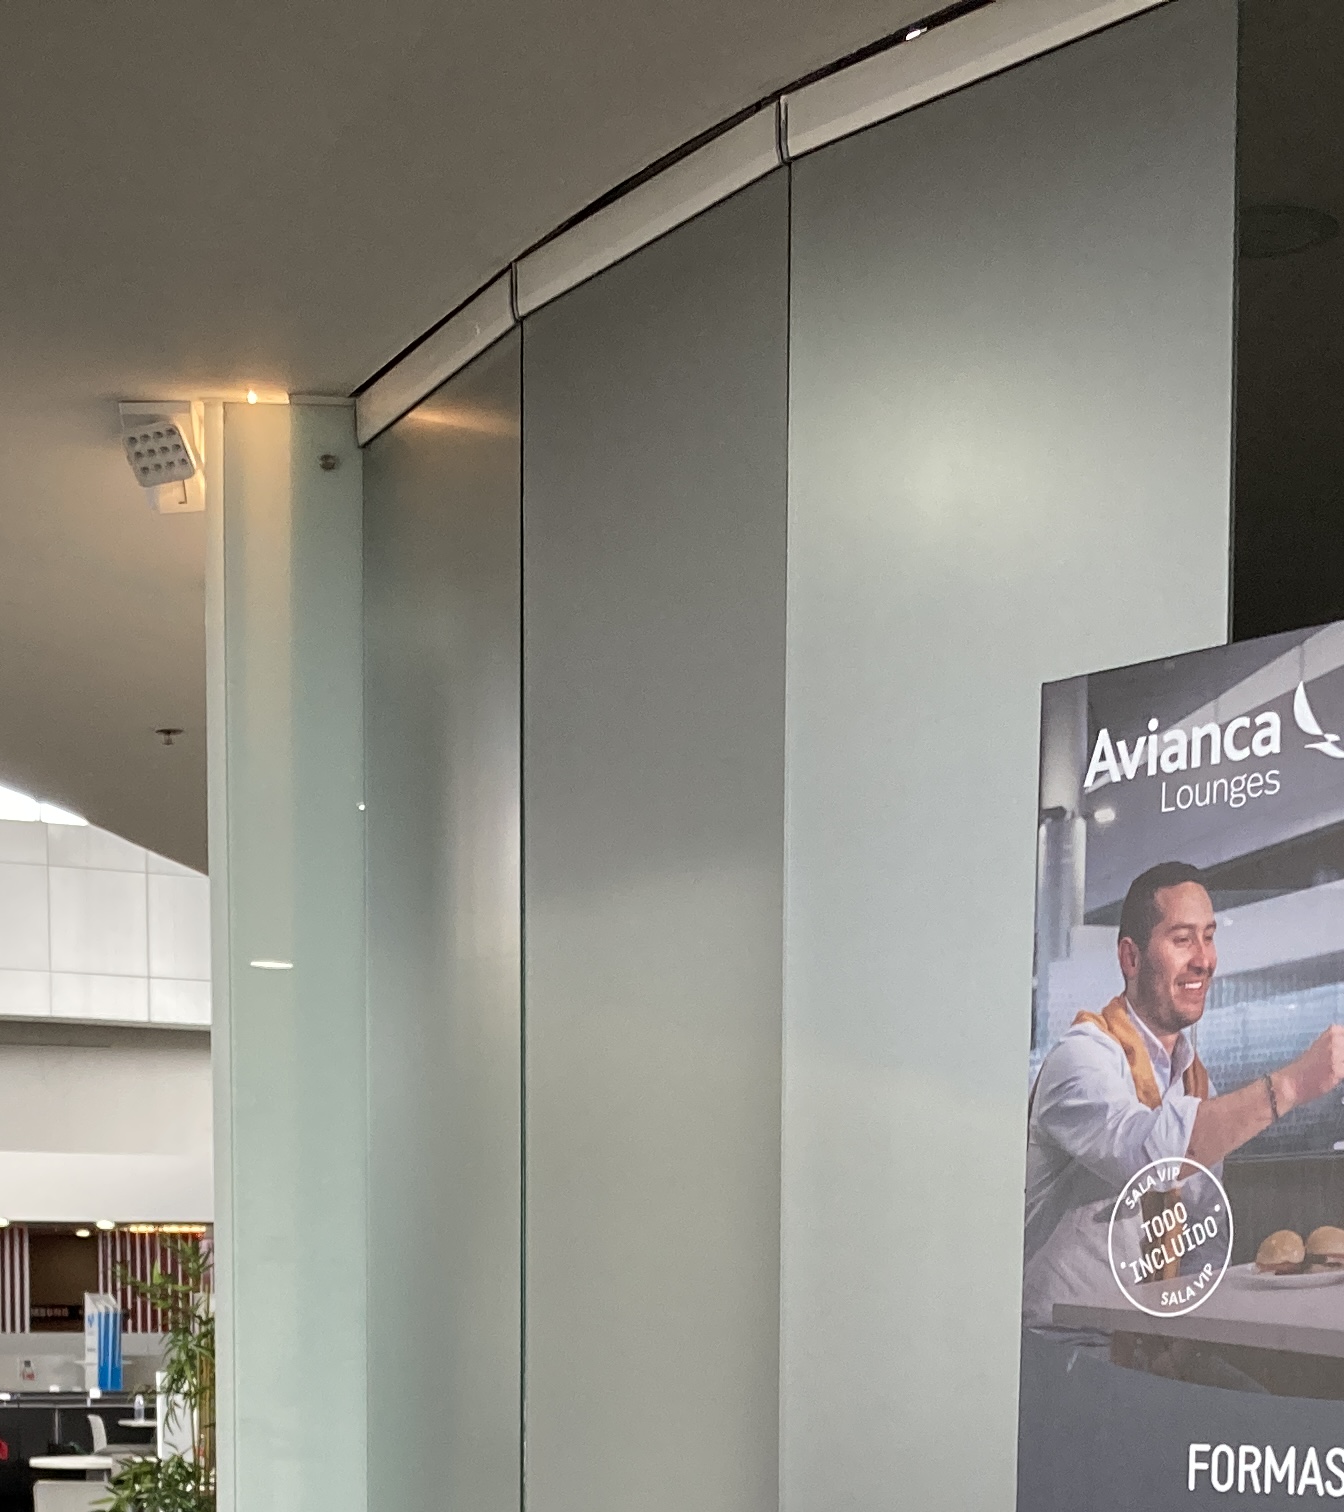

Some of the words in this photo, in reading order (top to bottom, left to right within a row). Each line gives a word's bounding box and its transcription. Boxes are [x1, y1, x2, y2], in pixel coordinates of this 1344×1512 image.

[1085, 711, 1281, 788] Avianca
[1161, 769, 1281, 814] Lounges
[1125, 1175, 1157, 1209] SALA
[1157, 1166, 1181, 1182] VIP
[1141, 1202, 1188, 1243] TODO
[1128, 1215, 1218, 1284] INCLUÍDO
[1160, 1286, 1196, 1306] SALA
[1193, 1263, 1213, 1290] VIP
